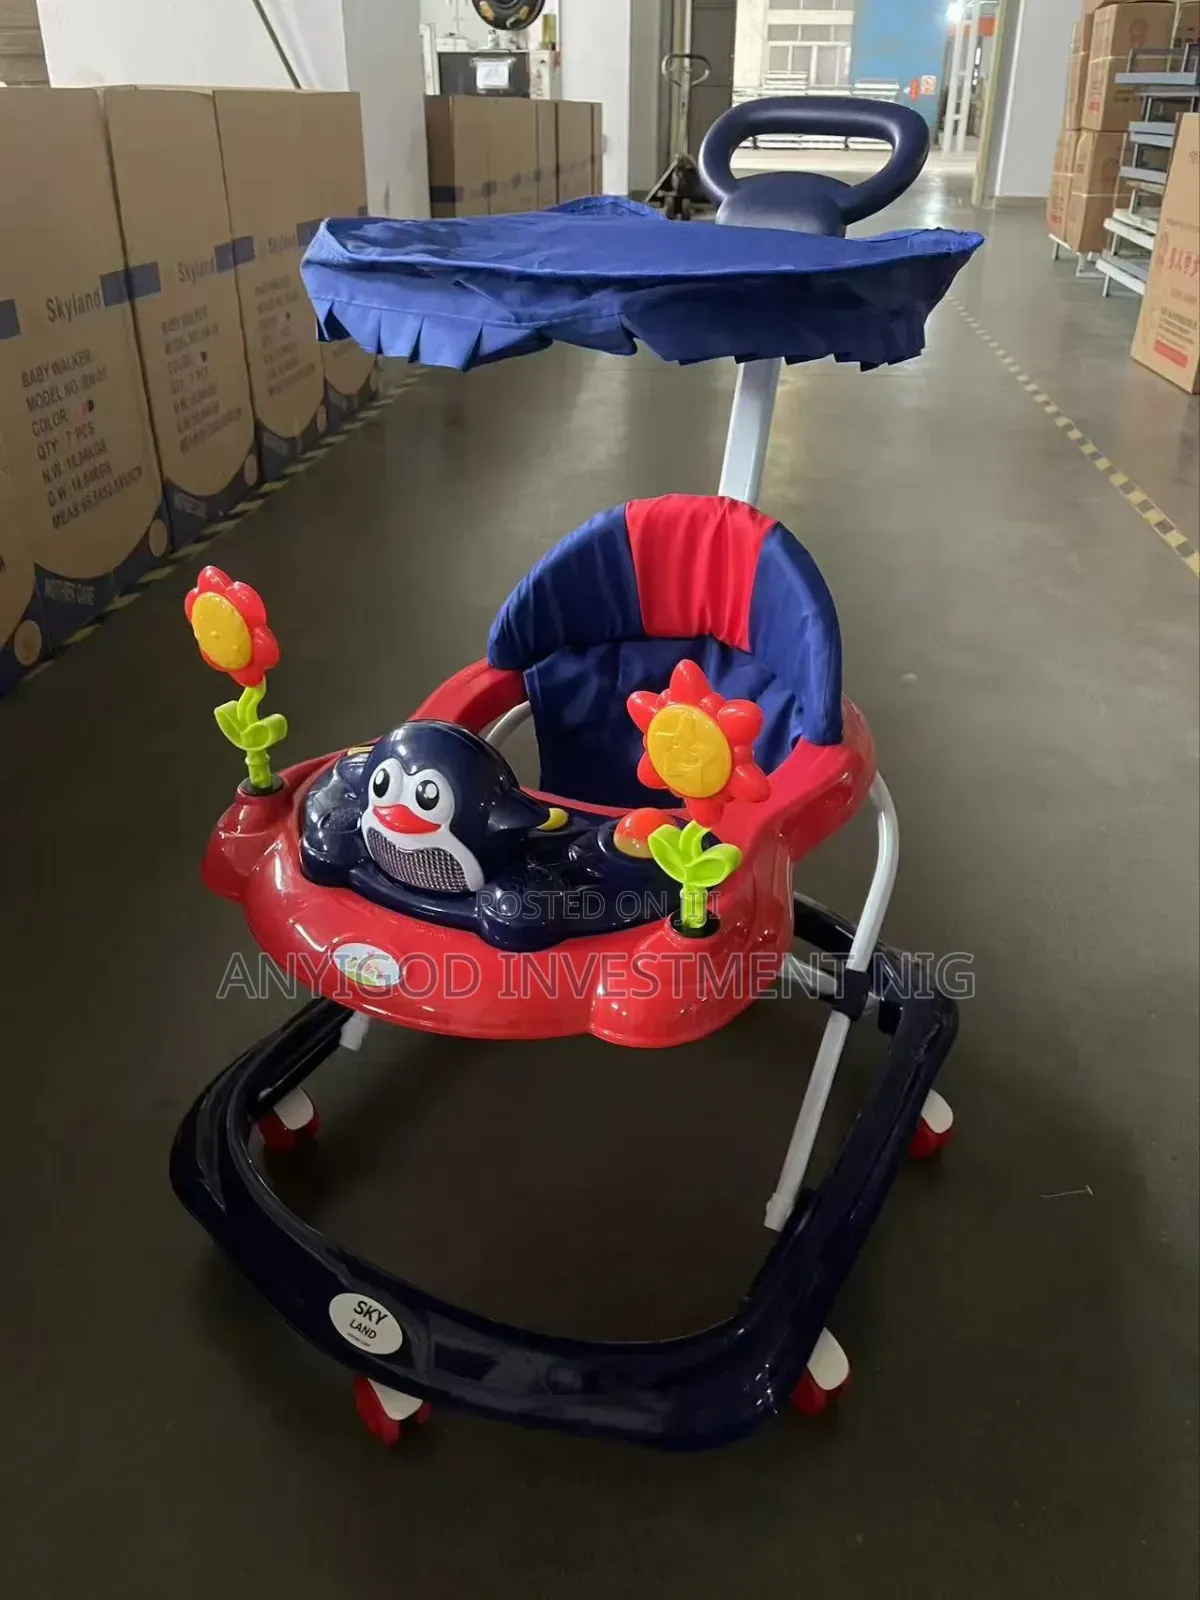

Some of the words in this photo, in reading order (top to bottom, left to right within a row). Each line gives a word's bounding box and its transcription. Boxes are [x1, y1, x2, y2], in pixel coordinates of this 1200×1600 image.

[46, 287, 102, 324] Skyland
[31, 407, 69, 437] COLOR
[353, 1300, 389, 1325] SKY
[349, 1319, 377, 1339] LAND
